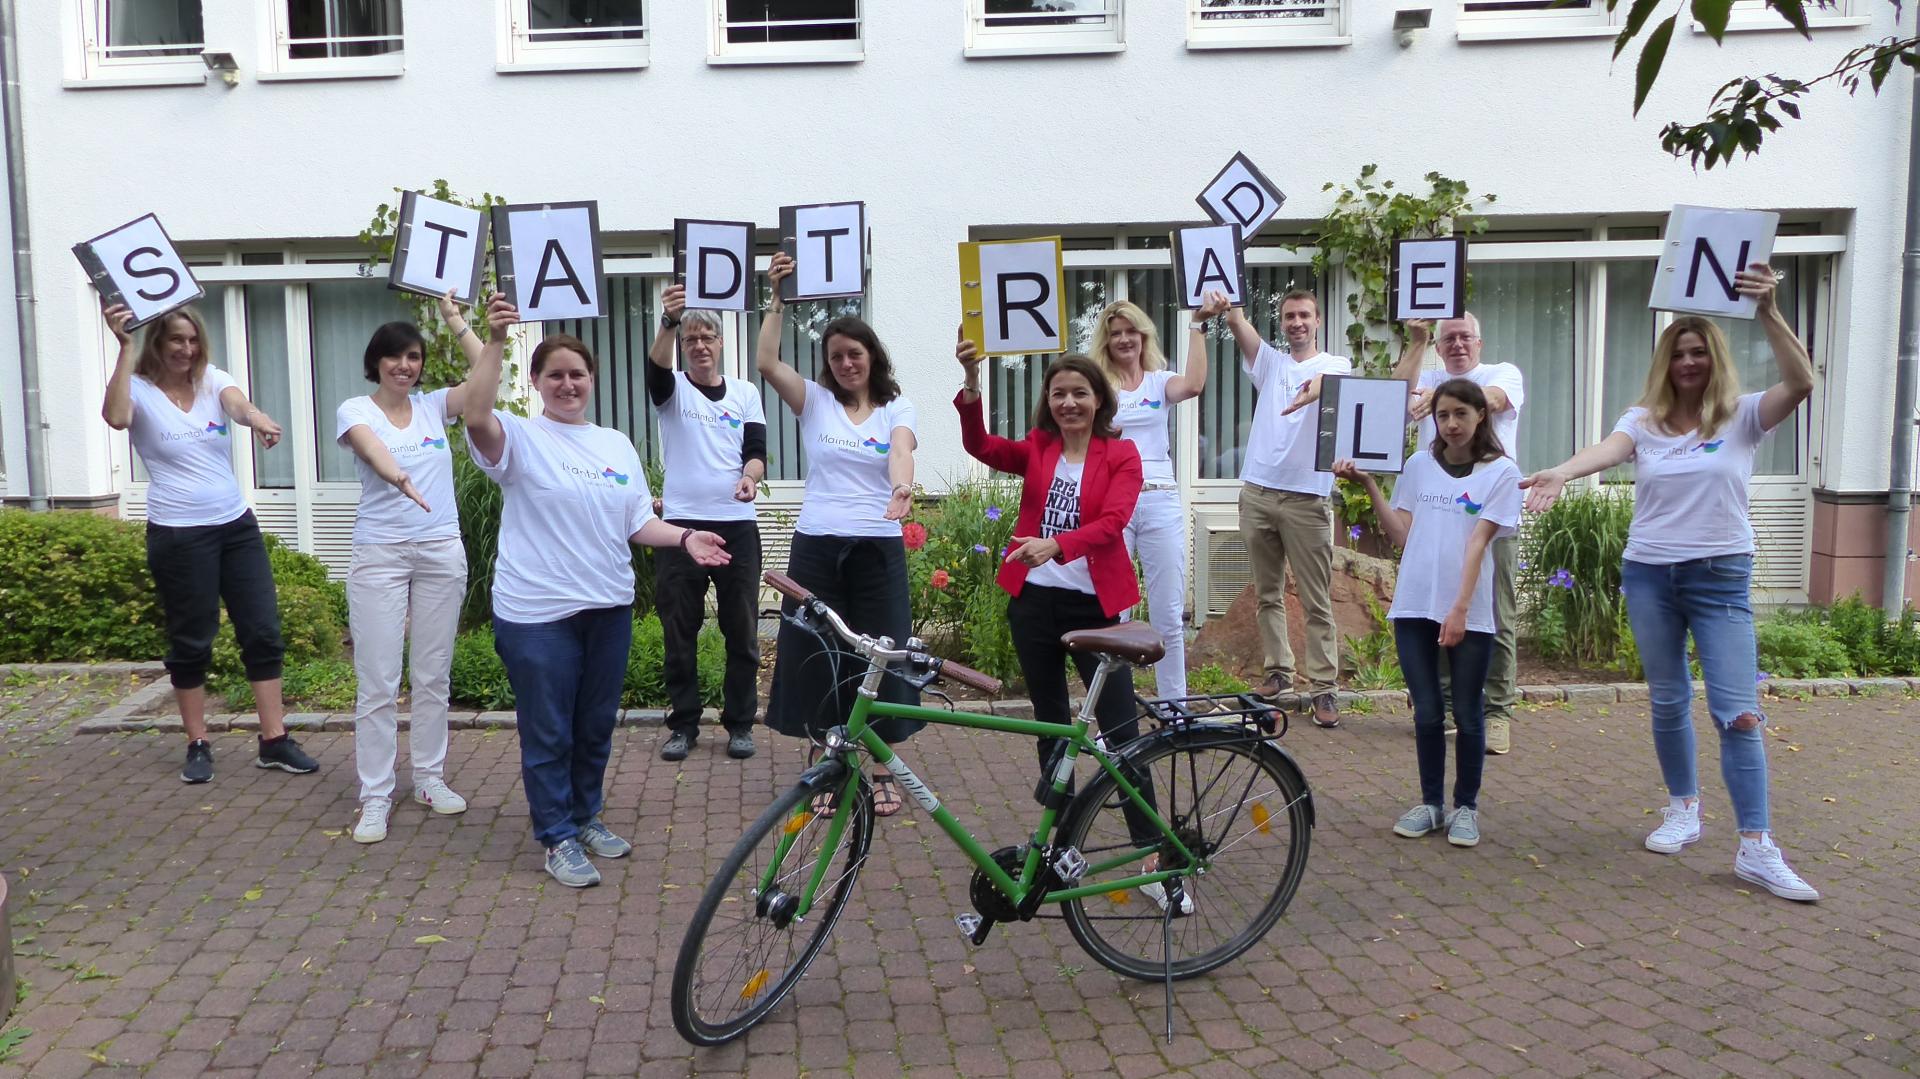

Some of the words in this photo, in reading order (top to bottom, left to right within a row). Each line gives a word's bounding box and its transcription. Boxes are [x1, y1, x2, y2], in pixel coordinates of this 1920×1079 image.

[1221, 181, 1265, 228] D
[123, 246, 181, 301] S
[424, 221, 467, 279] T
[528, 239, 591, 309] A
[697, 246, 742, 300] D
[807, 227, 850, 282] T
[1194, 247, 1236, 297] A
[1685, 236, 1752, 302] N
[996, 271, 1058, 340] R
[1410, 261, 1446, 310] E
[389, 442, 419, 454] aintal
[817, 432, 860, 448] Maintal
[1352, 402, 1388, 460] L
